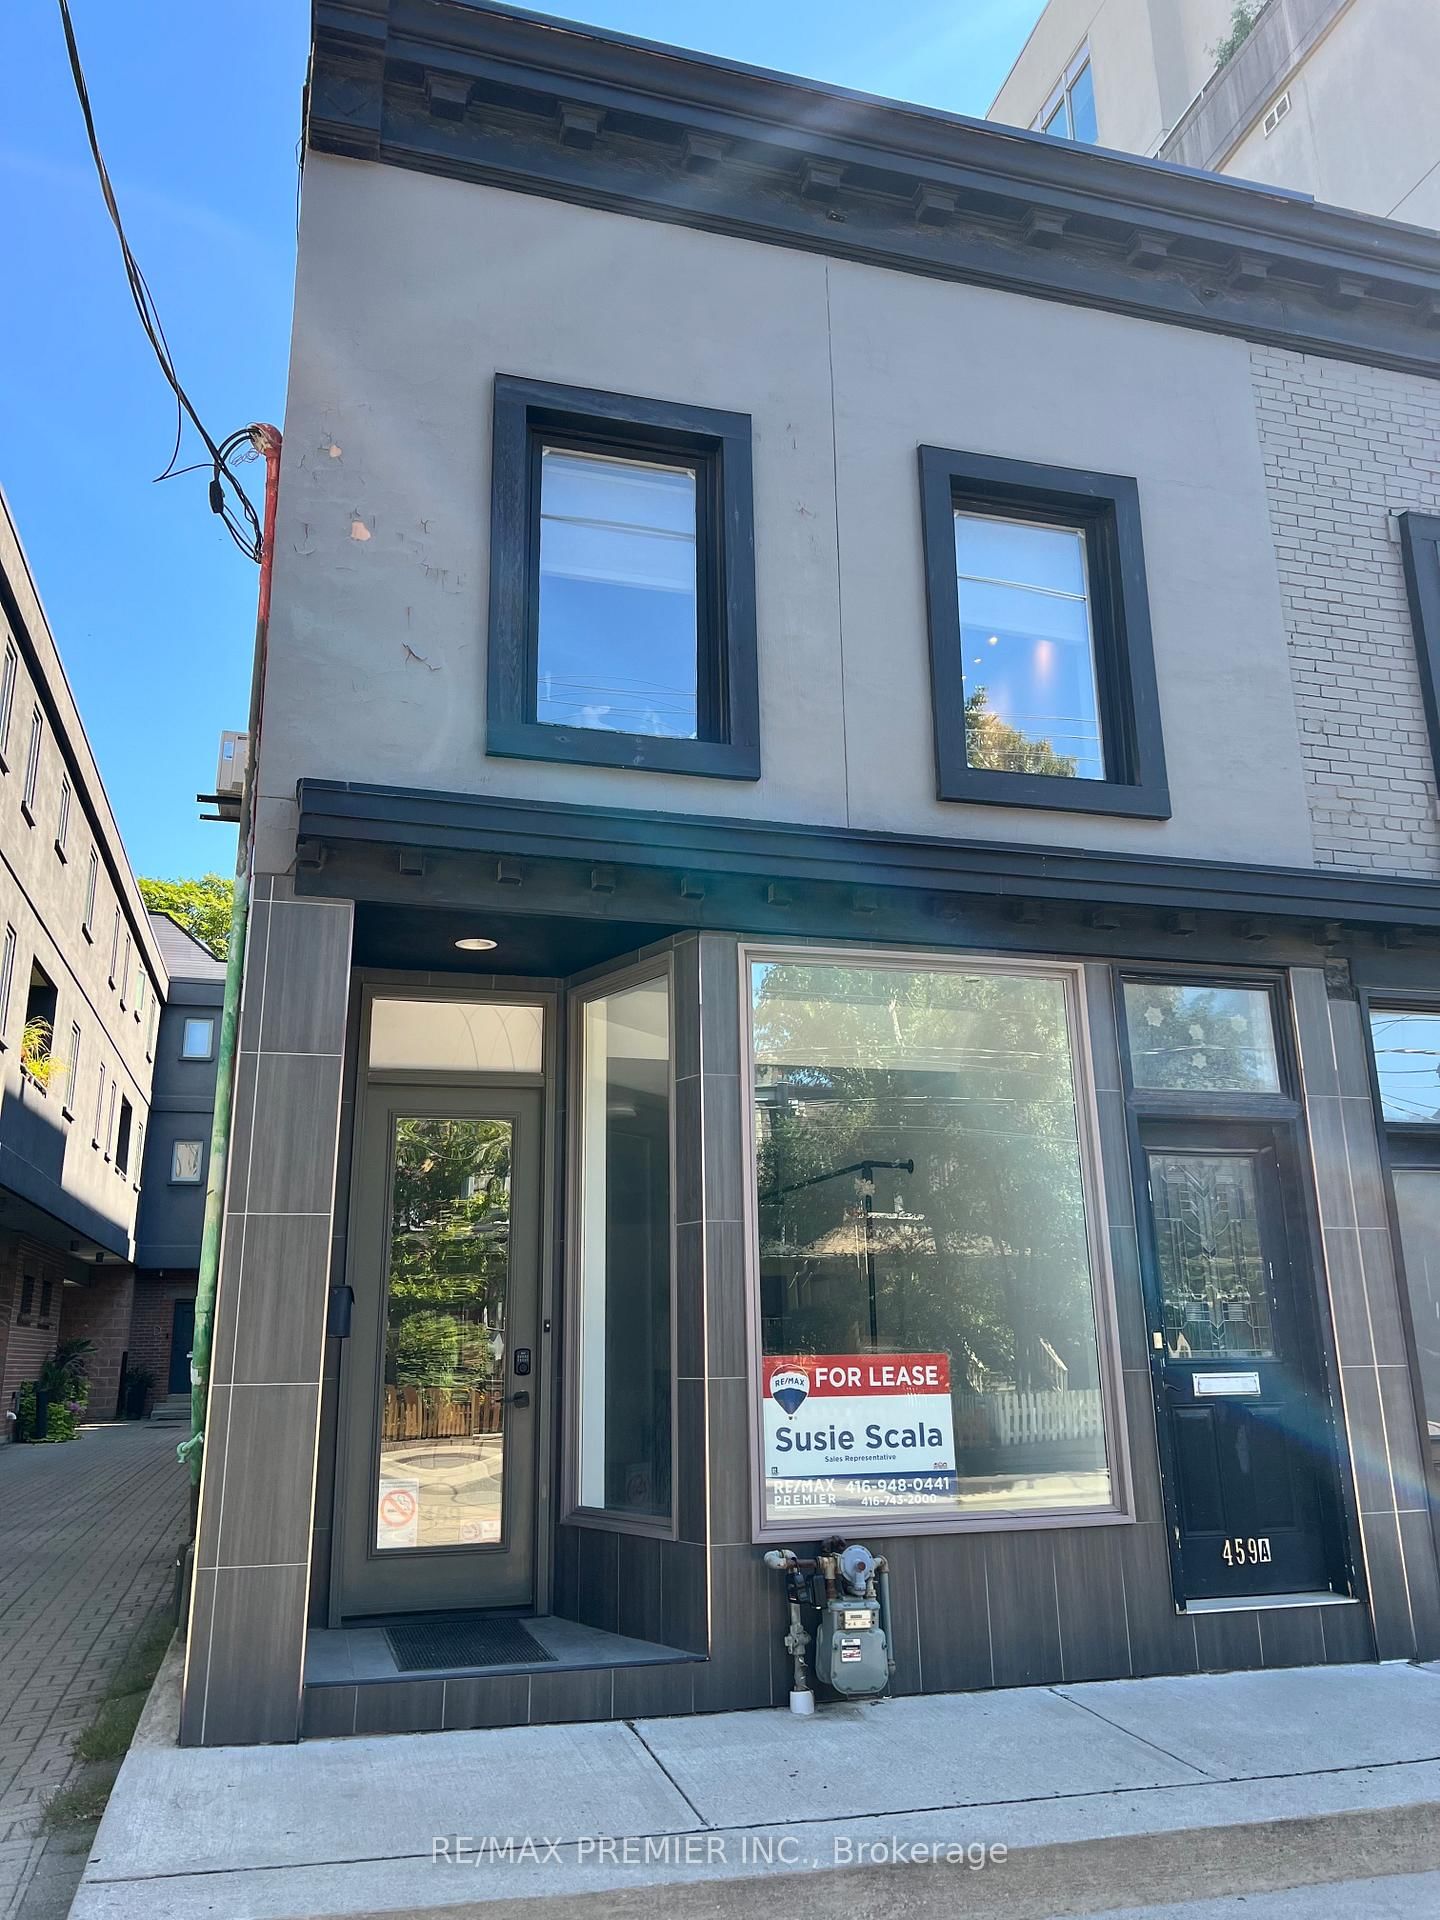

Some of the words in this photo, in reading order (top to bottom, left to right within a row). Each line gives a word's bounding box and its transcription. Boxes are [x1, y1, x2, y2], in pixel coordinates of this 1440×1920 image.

[774, 1377, 806, 1388] RE/MAX
[815, 1366, 862, 1388] FOR
[869, 1365, 939, 1387] LEASE
[775, 1424, 855, 1452] Susie
[865, 1422, 943, 1449] Scala
[824, 1455, 844, 1463] Sales
[844, 1454, 897, 1463] Representative
[774, 1478, 836, 1494] RE/MAX
[844, 1476, 950, 1494] 416-948-0441
[774, 1494, 836, 1505] PREMIER
[861, 1494, 937, 1507] 416-743-2000
[1223, 1538, 1272, 1566] 459A
